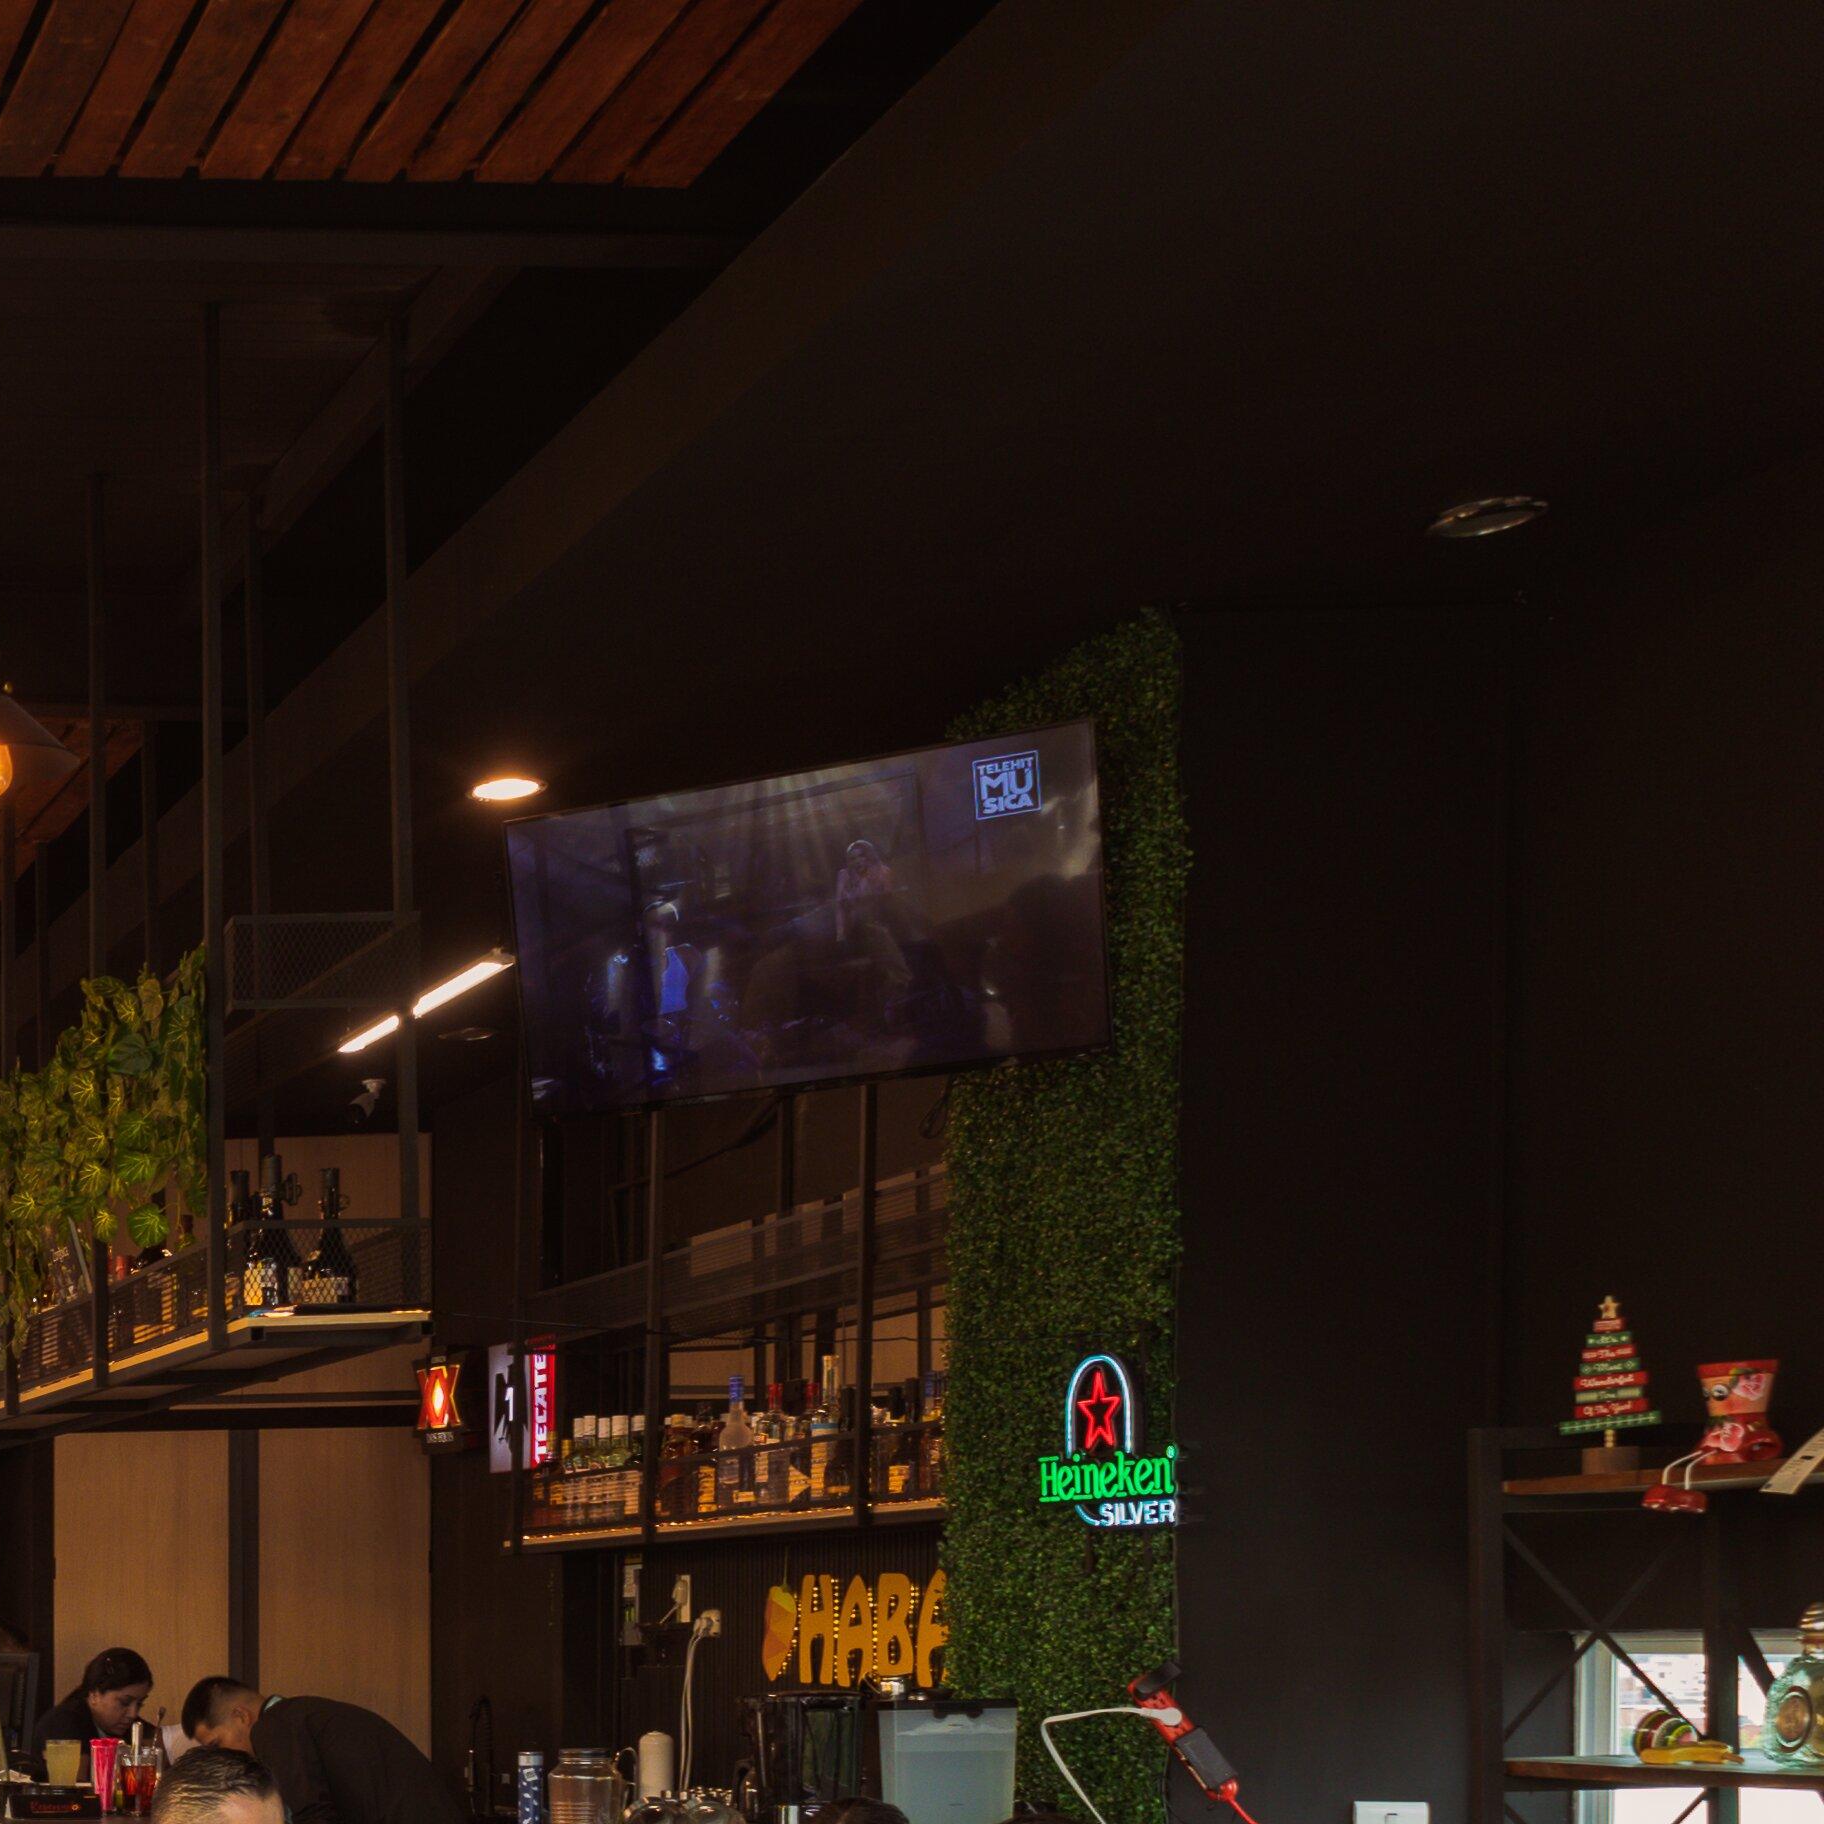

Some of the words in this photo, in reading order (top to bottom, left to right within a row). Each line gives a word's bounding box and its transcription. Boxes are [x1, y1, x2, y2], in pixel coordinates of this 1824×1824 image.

[976, 756, 1035, 776] TELEHIT
[982, 793, 1035, 815] SICA
[534, 1351, 549, 1465] TECATE
[1037, 1449, 1175, 1503] Heineken
[1098, 1498, 1177, 1527] SILVER
